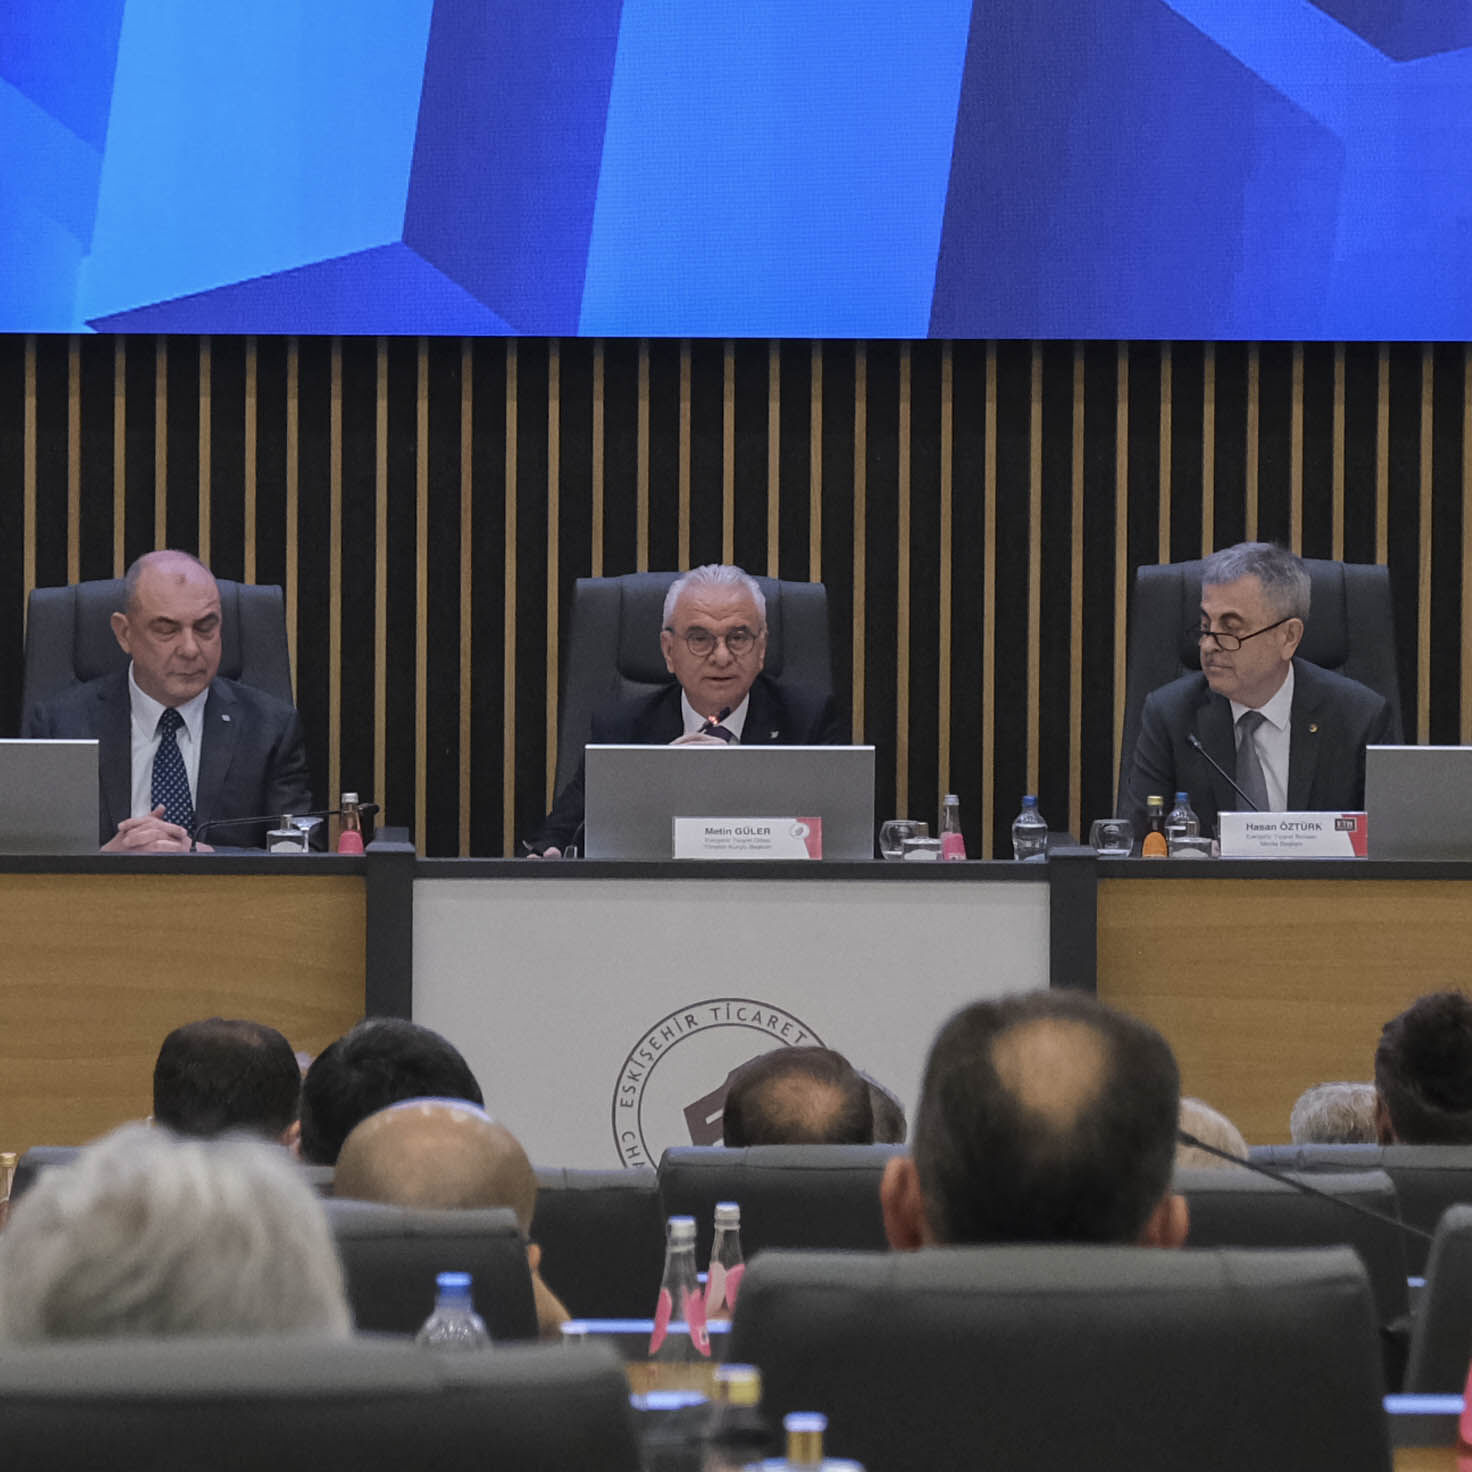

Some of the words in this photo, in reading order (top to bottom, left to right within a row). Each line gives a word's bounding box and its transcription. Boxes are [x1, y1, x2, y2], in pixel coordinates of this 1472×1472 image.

[704, 827, 732, 836] Metin
[734, 826, 771, 836] GÜLER
[1245, 822, 1277, 832] Hasan
[1279, 820, 1323, 832] ÖZTÜRK
[620, 1014, 699, 1108] ESKİŞEHİR
[708, 1002, 809, 1045] TİCARET
